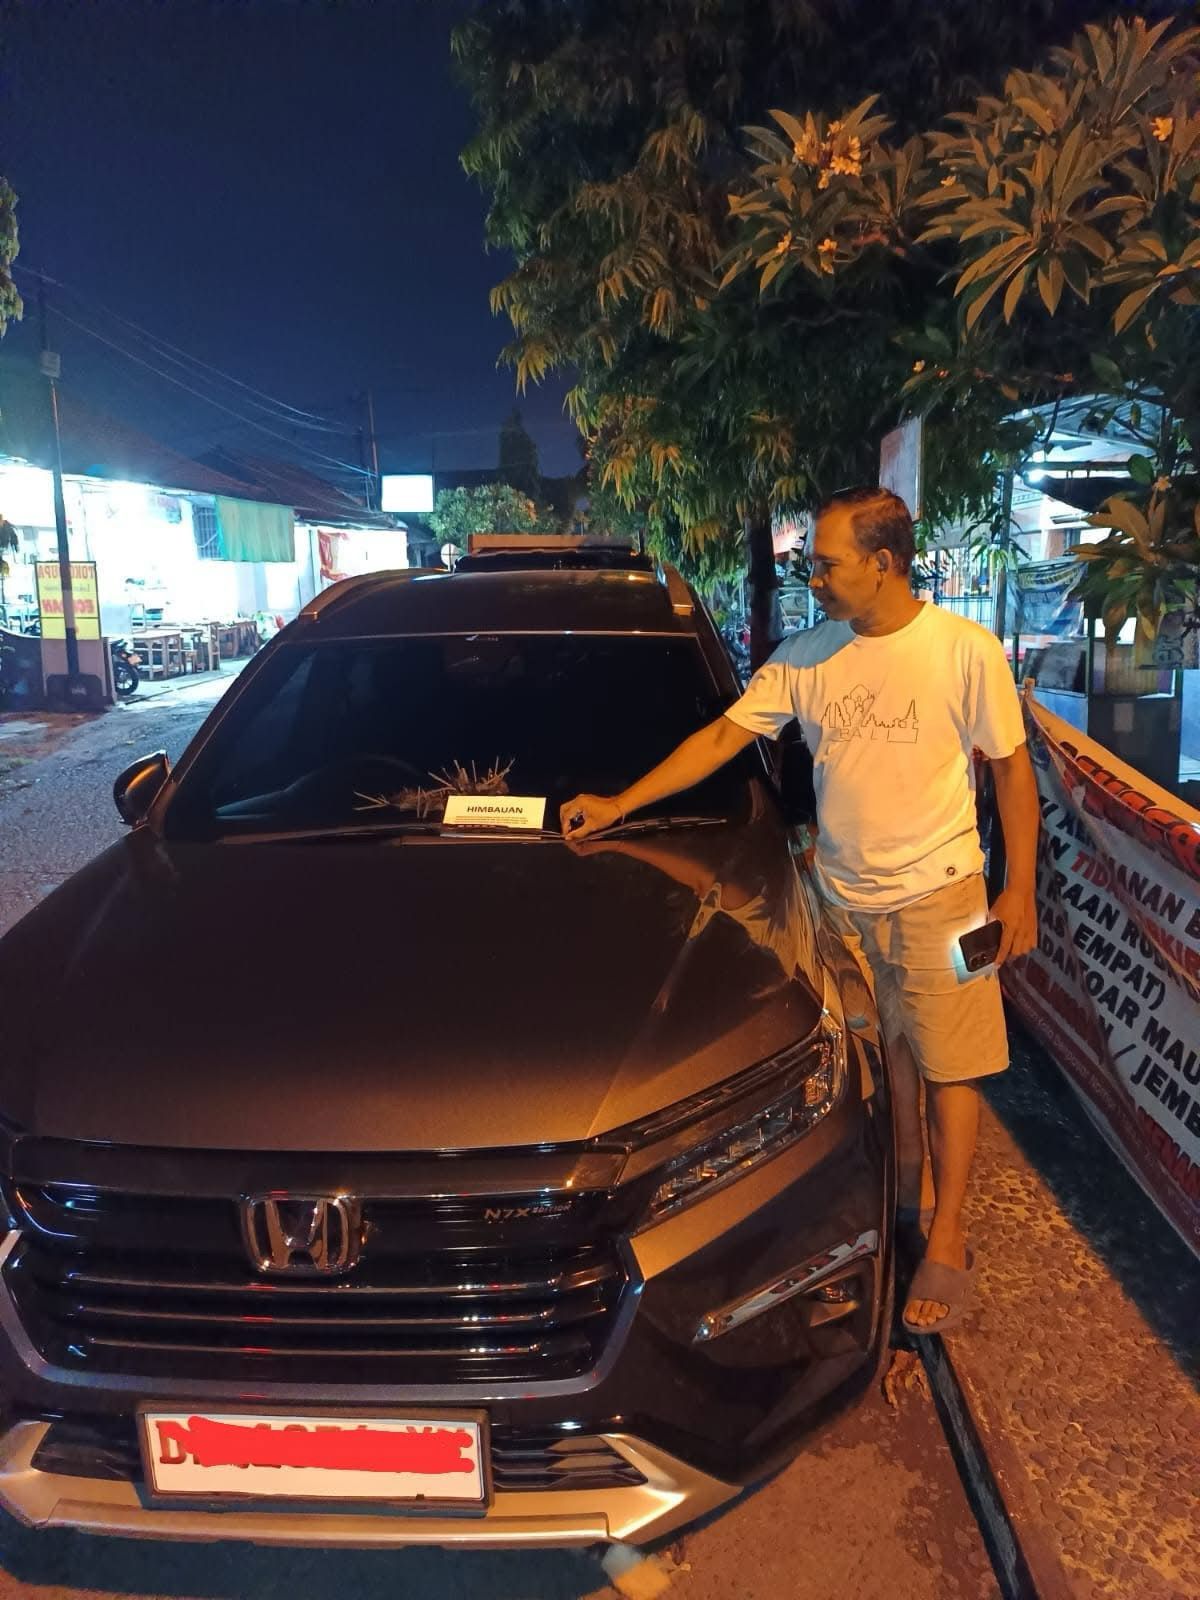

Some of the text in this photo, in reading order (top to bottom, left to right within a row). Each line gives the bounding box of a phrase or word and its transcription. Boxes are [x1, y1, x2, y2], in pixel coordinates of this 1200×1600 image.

[466, 805, 524, 814] HIMBAUAN
[1073, 922, 1166, 1011] EMPAT)
[483, 1207, 530, 1219] N7X
